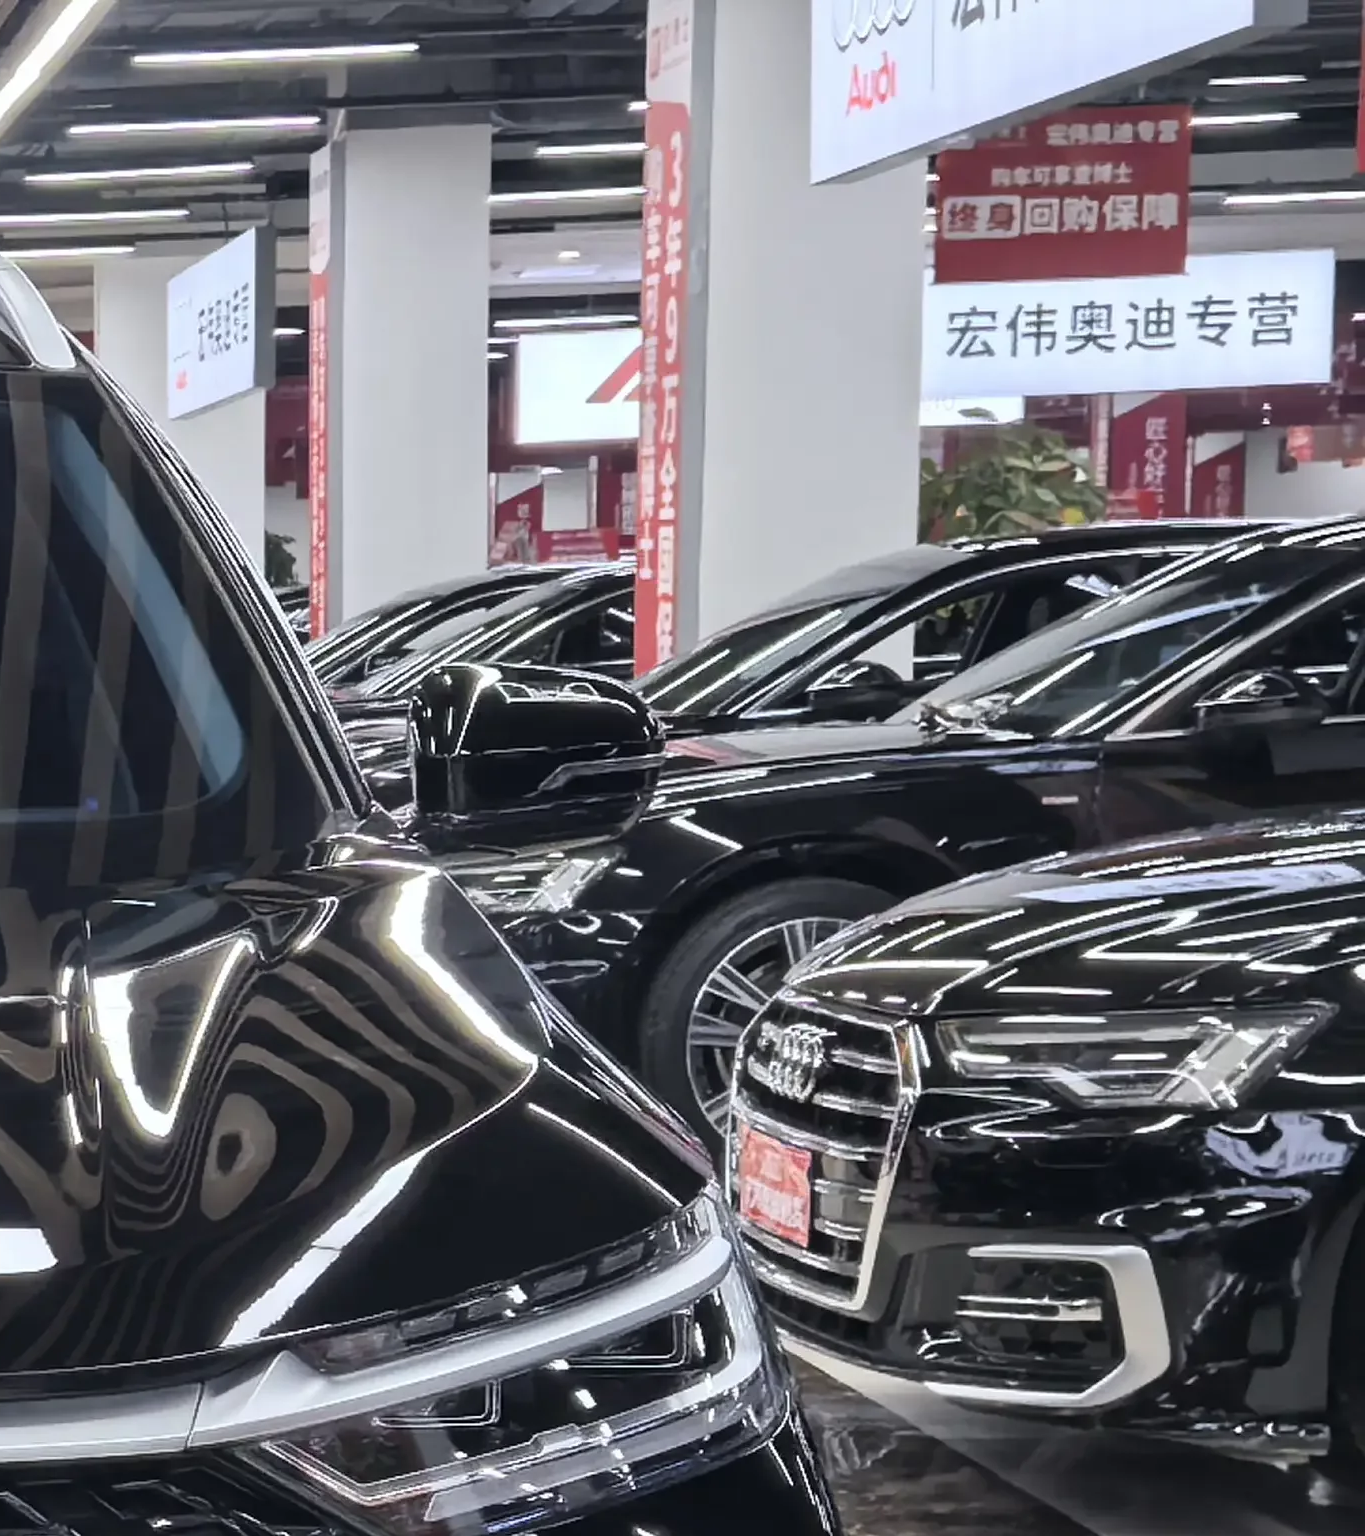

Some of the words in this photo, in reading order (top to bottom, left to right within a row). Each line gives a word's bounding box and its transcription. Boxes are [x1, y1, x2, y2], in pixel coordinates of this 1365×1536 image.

[846, 50, 897, 116] Audi
[991, 161, 1133, 188] 购车可享查博士
[947, 192, 1180, 235] 终身回购保障
[946, 291, 1299, 359] 宏伟奥迪专营
